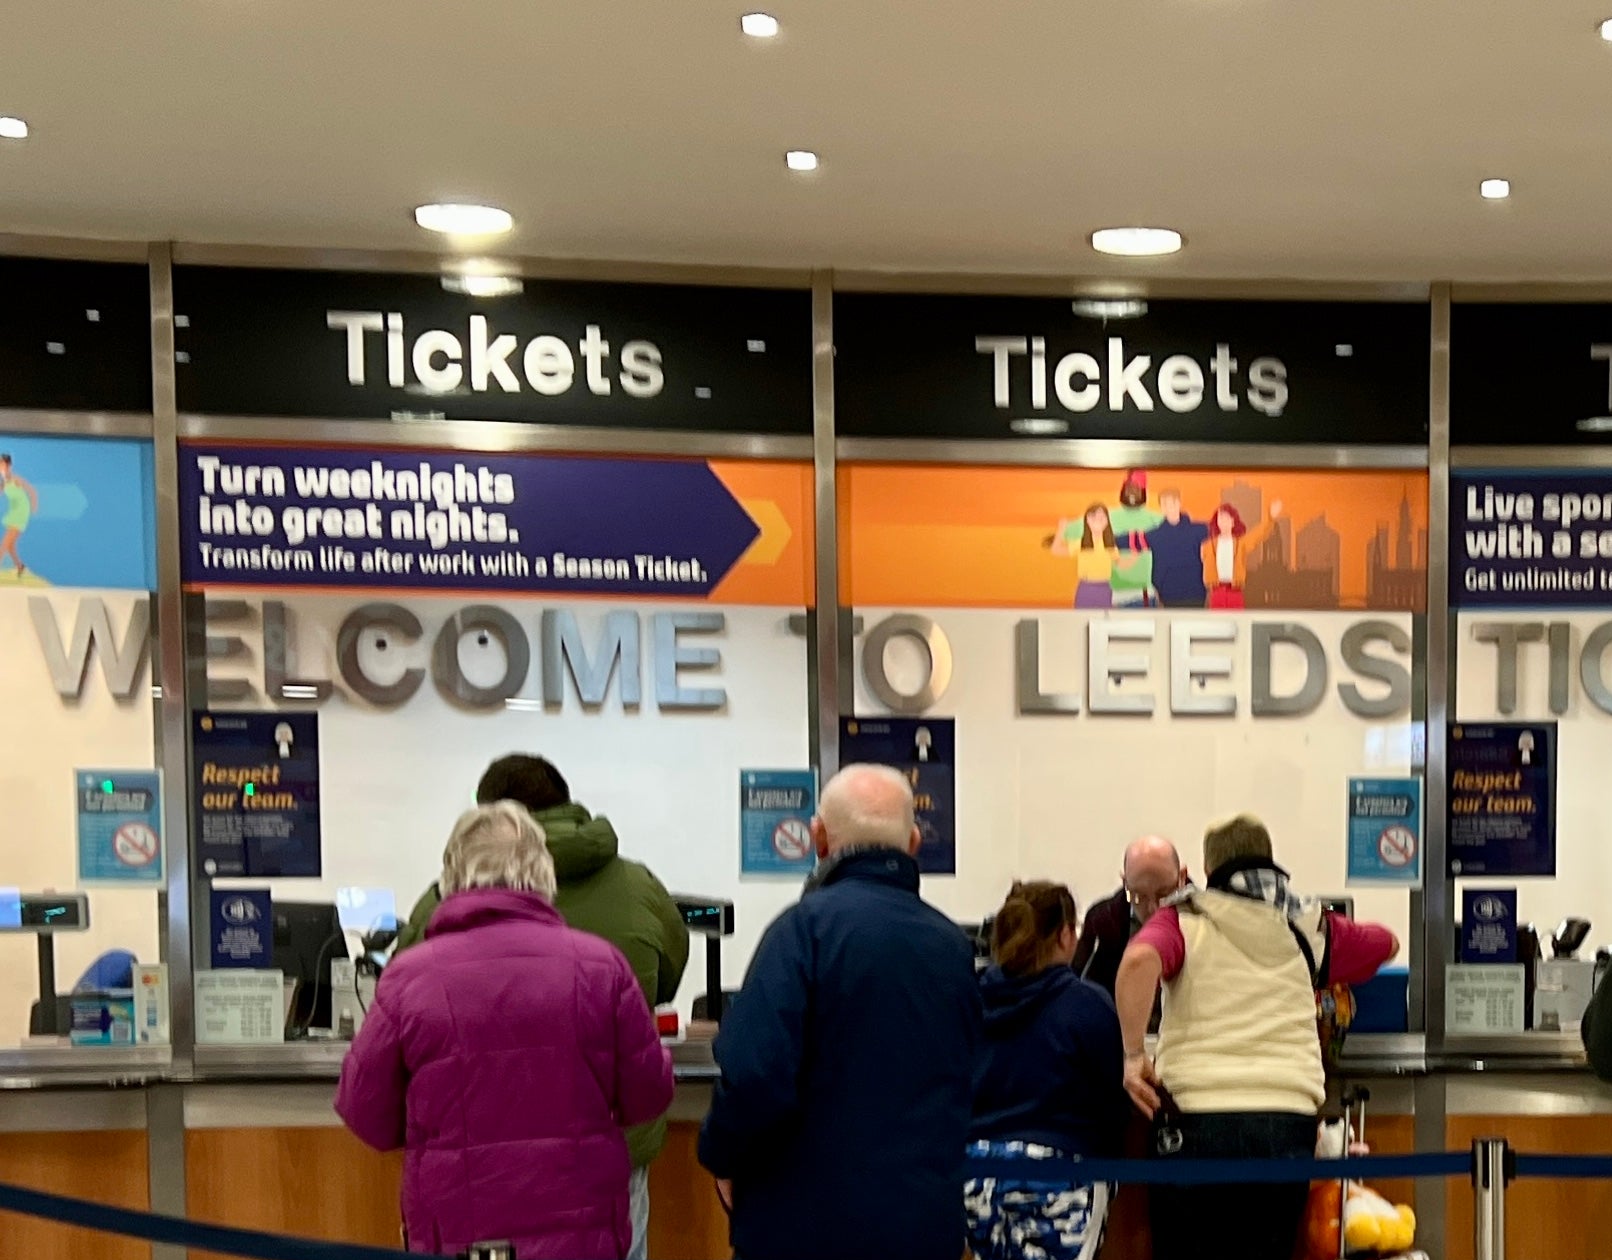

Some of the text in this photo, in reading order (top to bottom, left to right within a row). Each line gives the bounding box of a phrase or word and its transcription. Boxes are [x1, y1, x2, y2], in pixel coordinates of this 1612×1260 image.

[327, 310, 664, 397] Tickets
[976, 336, 1289, 414] Tickets
[197, 455, 515, 510] Turn weeknights
[1466, 485, 1534, 522] Live
[282, 503, 383, 545] great
[391, 502, 519, 550] nights.
[1465, 522, 1543, 559] with
[1552, 530, 1571, 558] a
[199, 542, 708, 583] Transform life after work with a Season Ticket.
[1464, 566, 1497, 592] Get
[1502, 565, 1594, 592] unlimited
[27, 594, 727, 710] WELCOME
[1016, 617, 1413, 717] LEEDS
[202, 762, 280, 789] Respect
[1453, 770, 1521, 794] Respect
[202, 791, 298, 811] our team.
[1452, 796, 1536, 814] our team.
